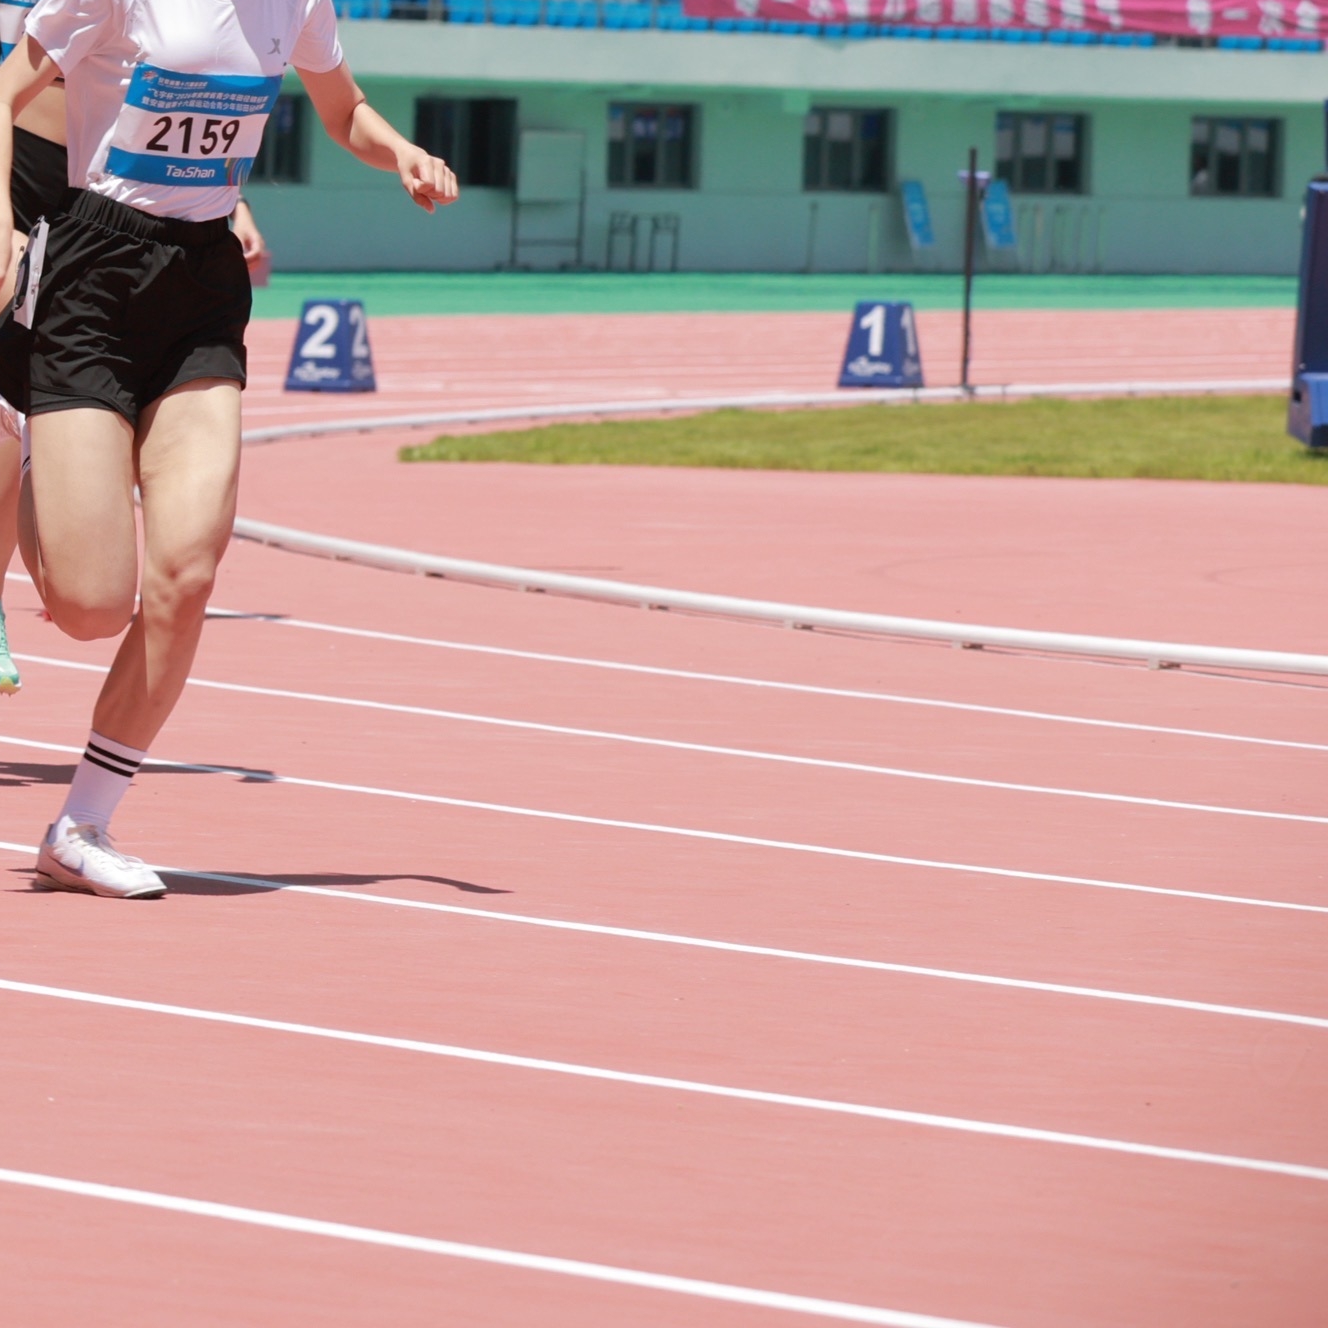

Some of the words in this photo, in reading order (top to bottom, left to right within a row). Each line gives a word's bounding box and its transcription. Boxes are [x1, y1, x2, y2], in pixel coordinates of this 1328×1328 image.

[145, 115, 240, 156] 2159
[165, 164, 216, 179] TaiShan
[299, 304, 340, 359] 2
[859, 304, 887, 357] 1
